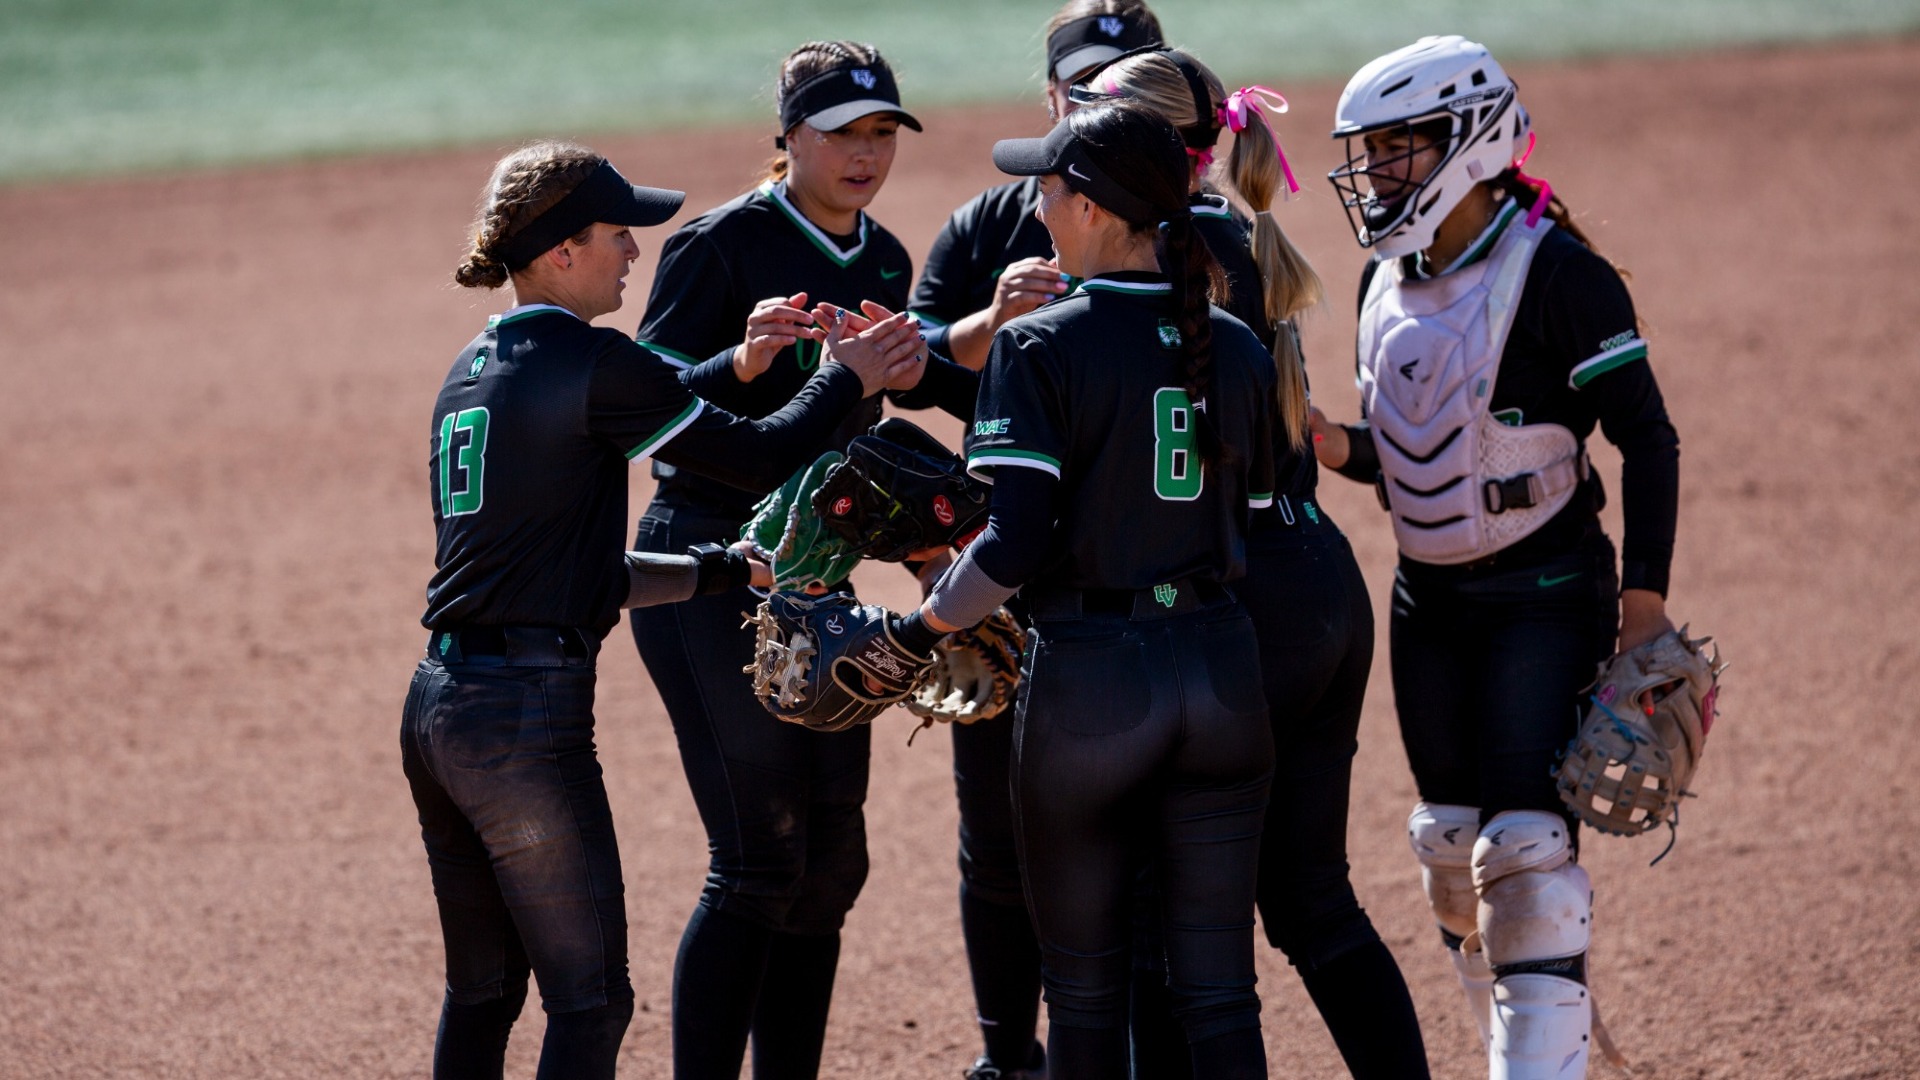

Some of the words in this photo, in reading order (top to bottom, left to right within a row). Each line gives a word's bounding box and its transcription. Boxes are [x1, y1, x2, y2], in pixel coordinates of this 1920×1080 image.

[975, 418, 1011, 435] WAC
[1154, 386, 1205, 501] 8
[439, 406, 490, 519] 13
[1154, 583, 1177, 607] UV
